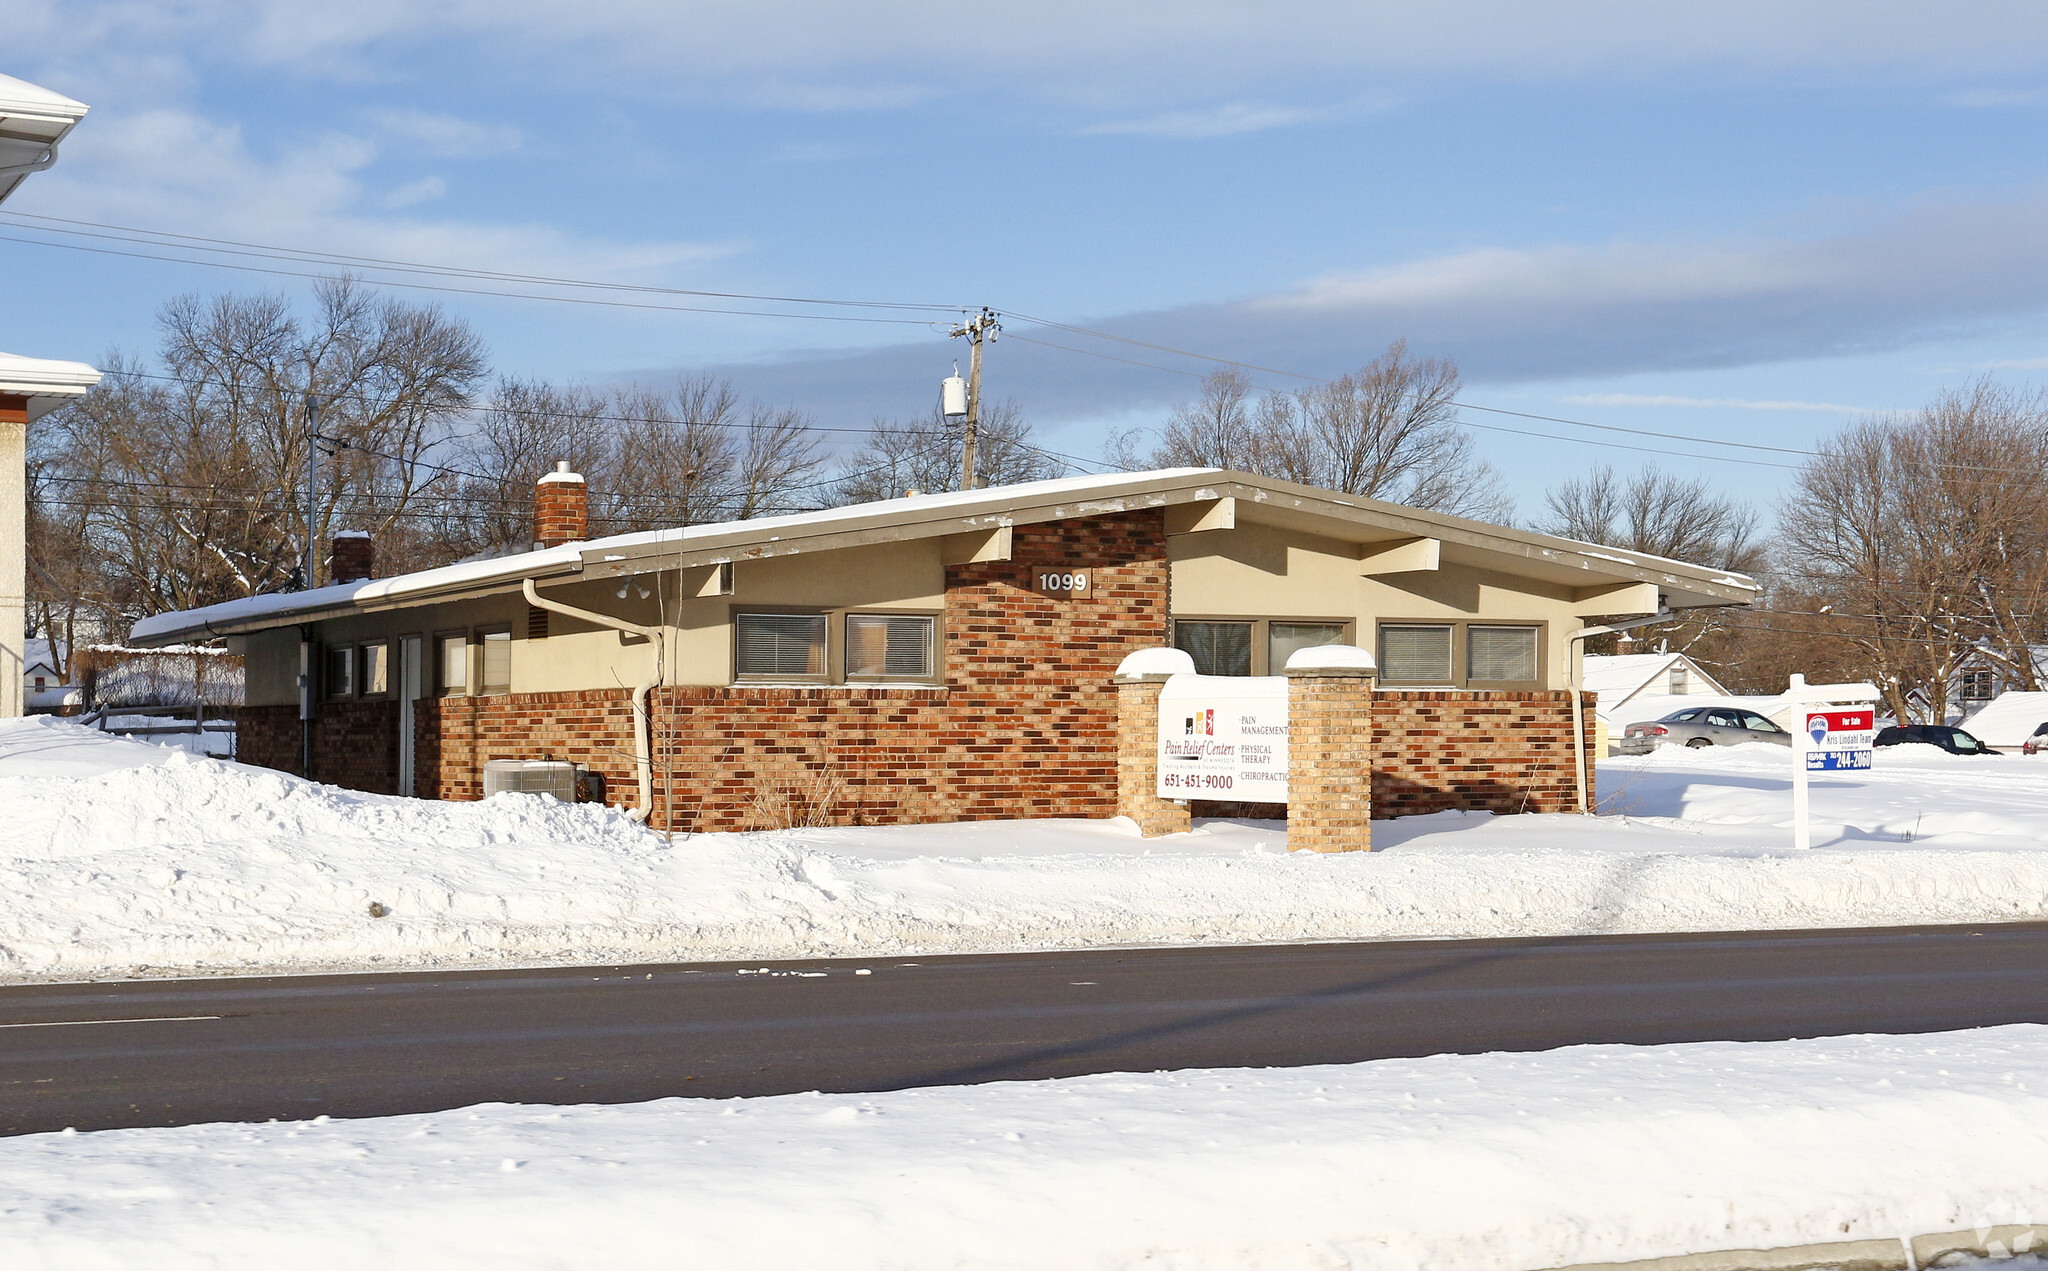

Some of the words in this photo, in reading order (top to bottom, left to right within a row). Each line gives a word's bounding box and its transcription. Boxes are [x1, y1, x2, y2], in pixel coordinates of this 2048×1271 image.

[1039, 573, 1087, 591] 1099
[1241, 716, 1256, 725] PAIN
[1842, 718, 1850, 726] For
[1851, 717, 1861, 725] Sale
[1241, 726, 1288, 735] MANAGEMENT
[1827, 735, 1838, 745] Kris
[1839, 734, 1858, 745] Lindahl
[1859, 734, 1871, 744] Team
[1164, 740, 1182, 755] Pain
[1183, 739, 1207, 760] Relief
[1206, 740, 1235, 756] Centers
[1241, 745, 1272, 754] PHYSICAL
[1241, 755, 1271, 764] THERAPY
[1836, 751, 1870, 768] 244-2060
[1164, 774, 1233, 789] 651-451-9000
